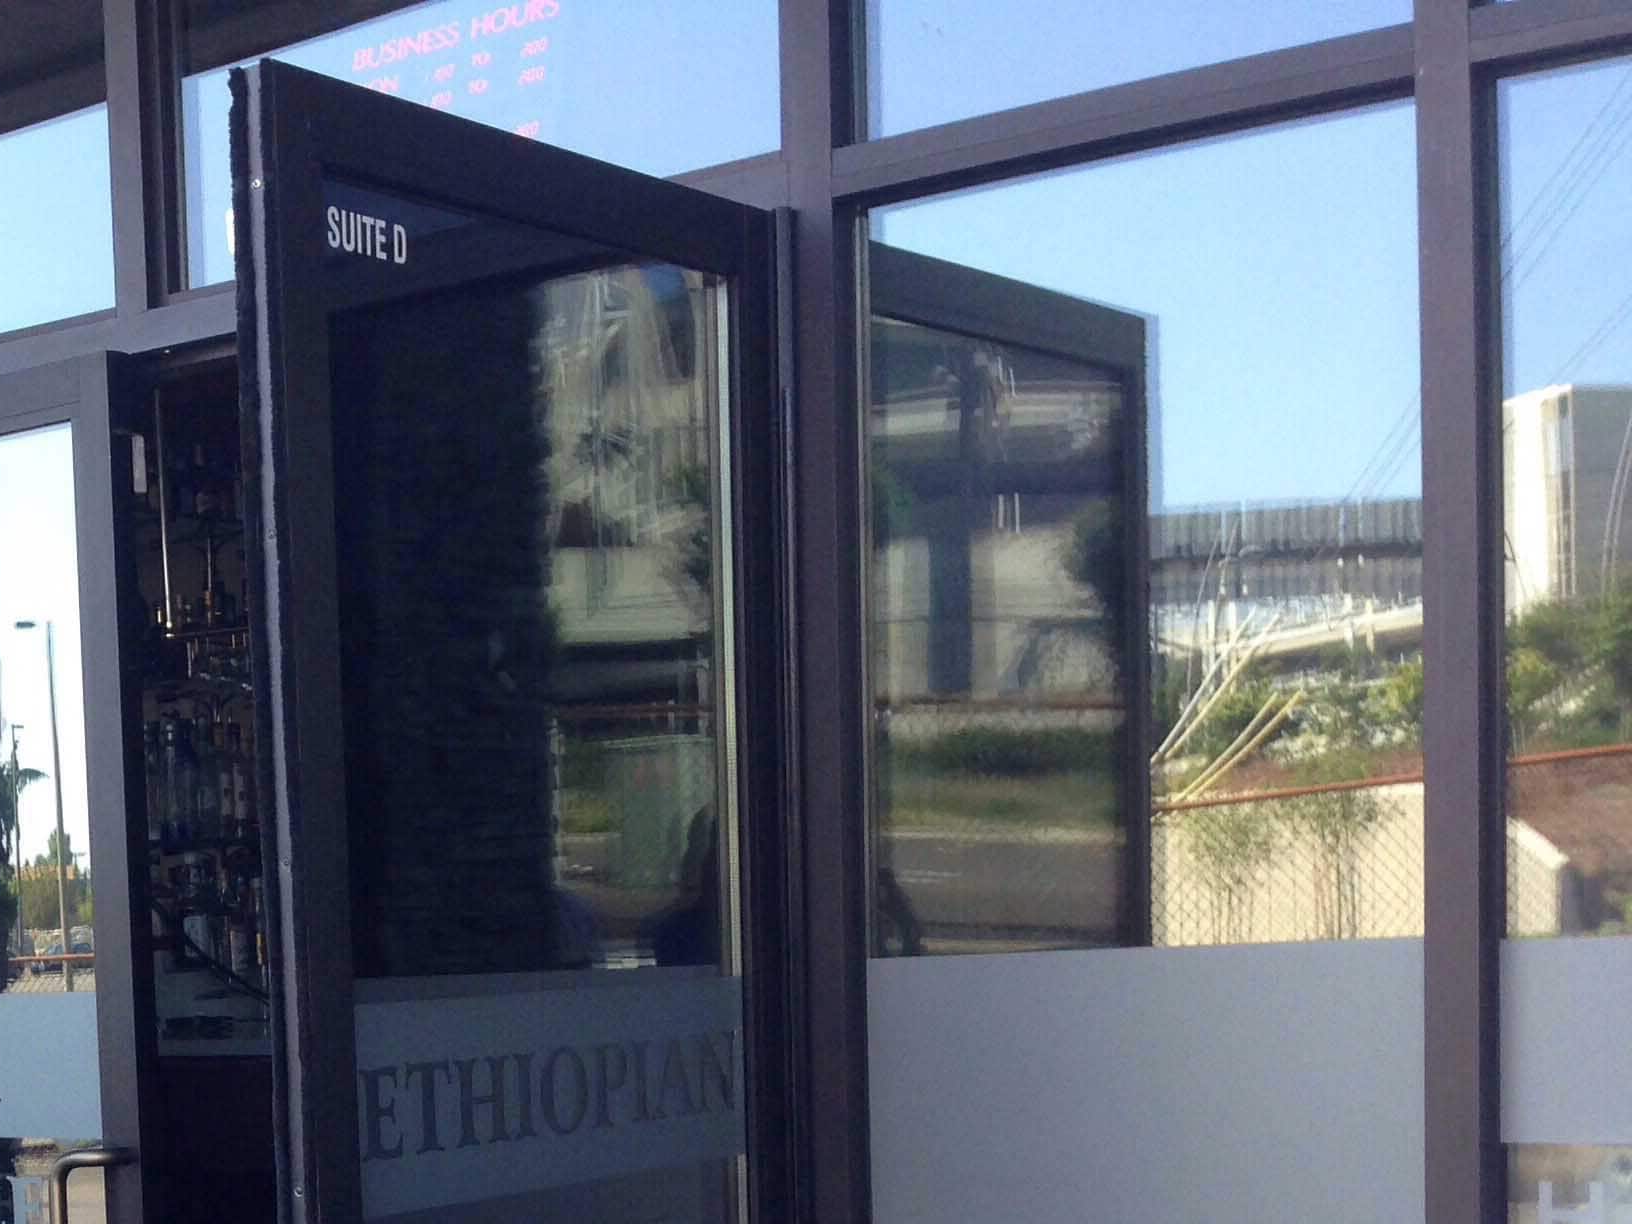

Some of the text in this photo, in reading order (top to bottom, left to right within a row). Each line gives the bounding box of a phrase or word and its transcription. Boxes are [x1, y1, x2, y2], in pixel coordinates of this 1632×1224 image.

[352, 0, 560, 72] BUSINESS HOURS
[328, 205, 407, 265] SUITE D
[357, 1030, 734, 1161] ETHIOPIAN
